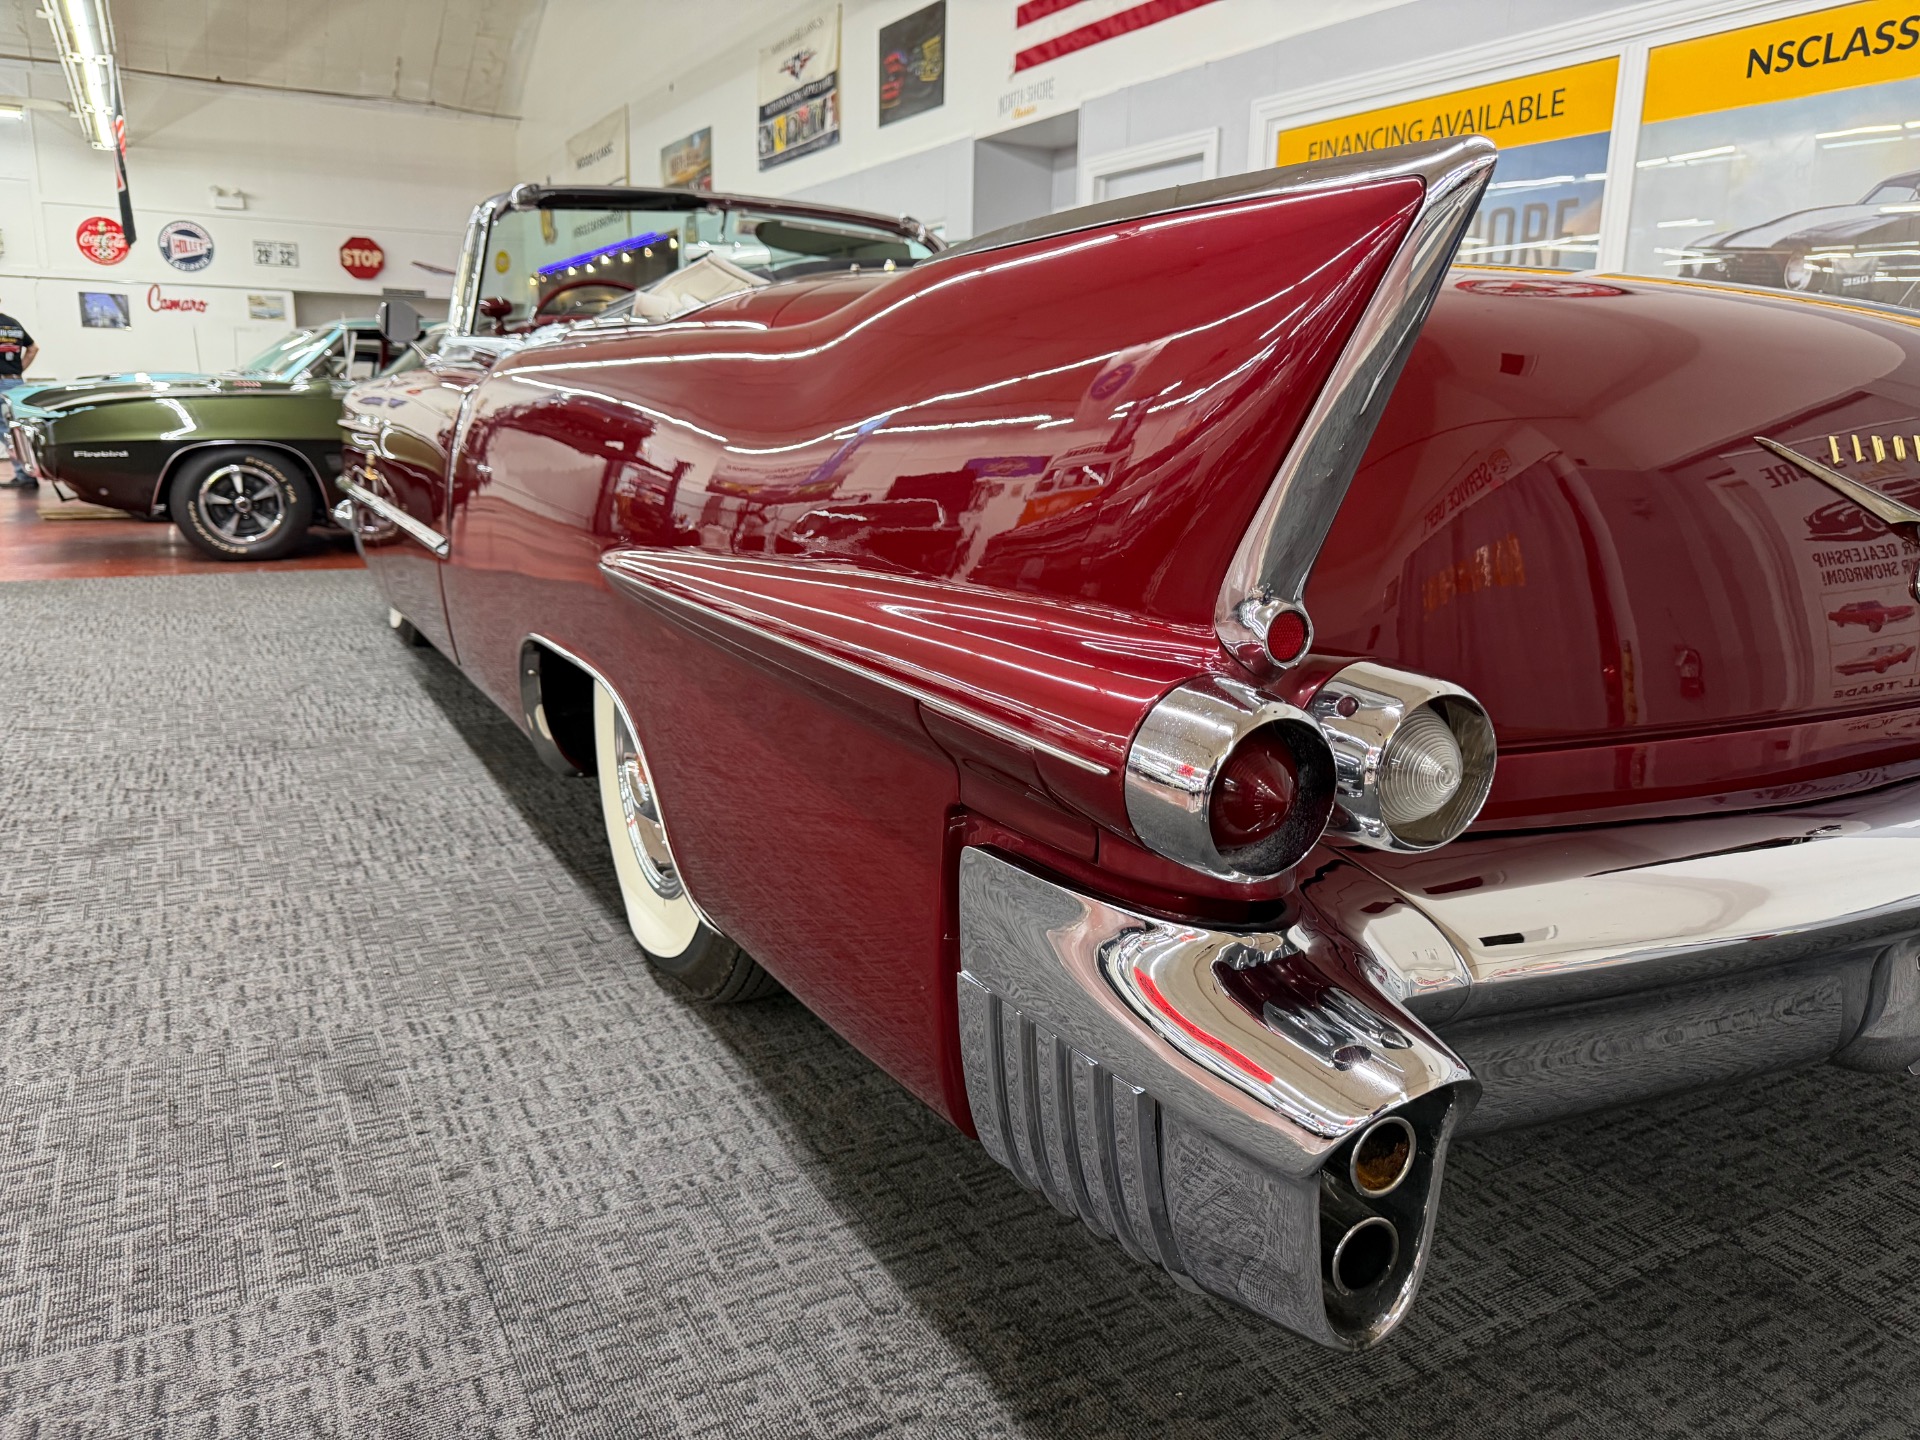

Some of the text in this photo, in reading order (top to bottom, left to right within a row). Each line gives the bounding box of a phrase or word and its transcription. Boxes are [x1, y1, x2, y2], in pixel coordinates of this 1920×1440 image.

[1746, 15, 1920, 78] NSCLASS
[1308, 88, 1565, 160] FINANCING AVAILABLE
[341, 249, 383, 268] STOP
[147, 283, 208, 313] Camaro
[74, 450, 129, 458] Firebird
